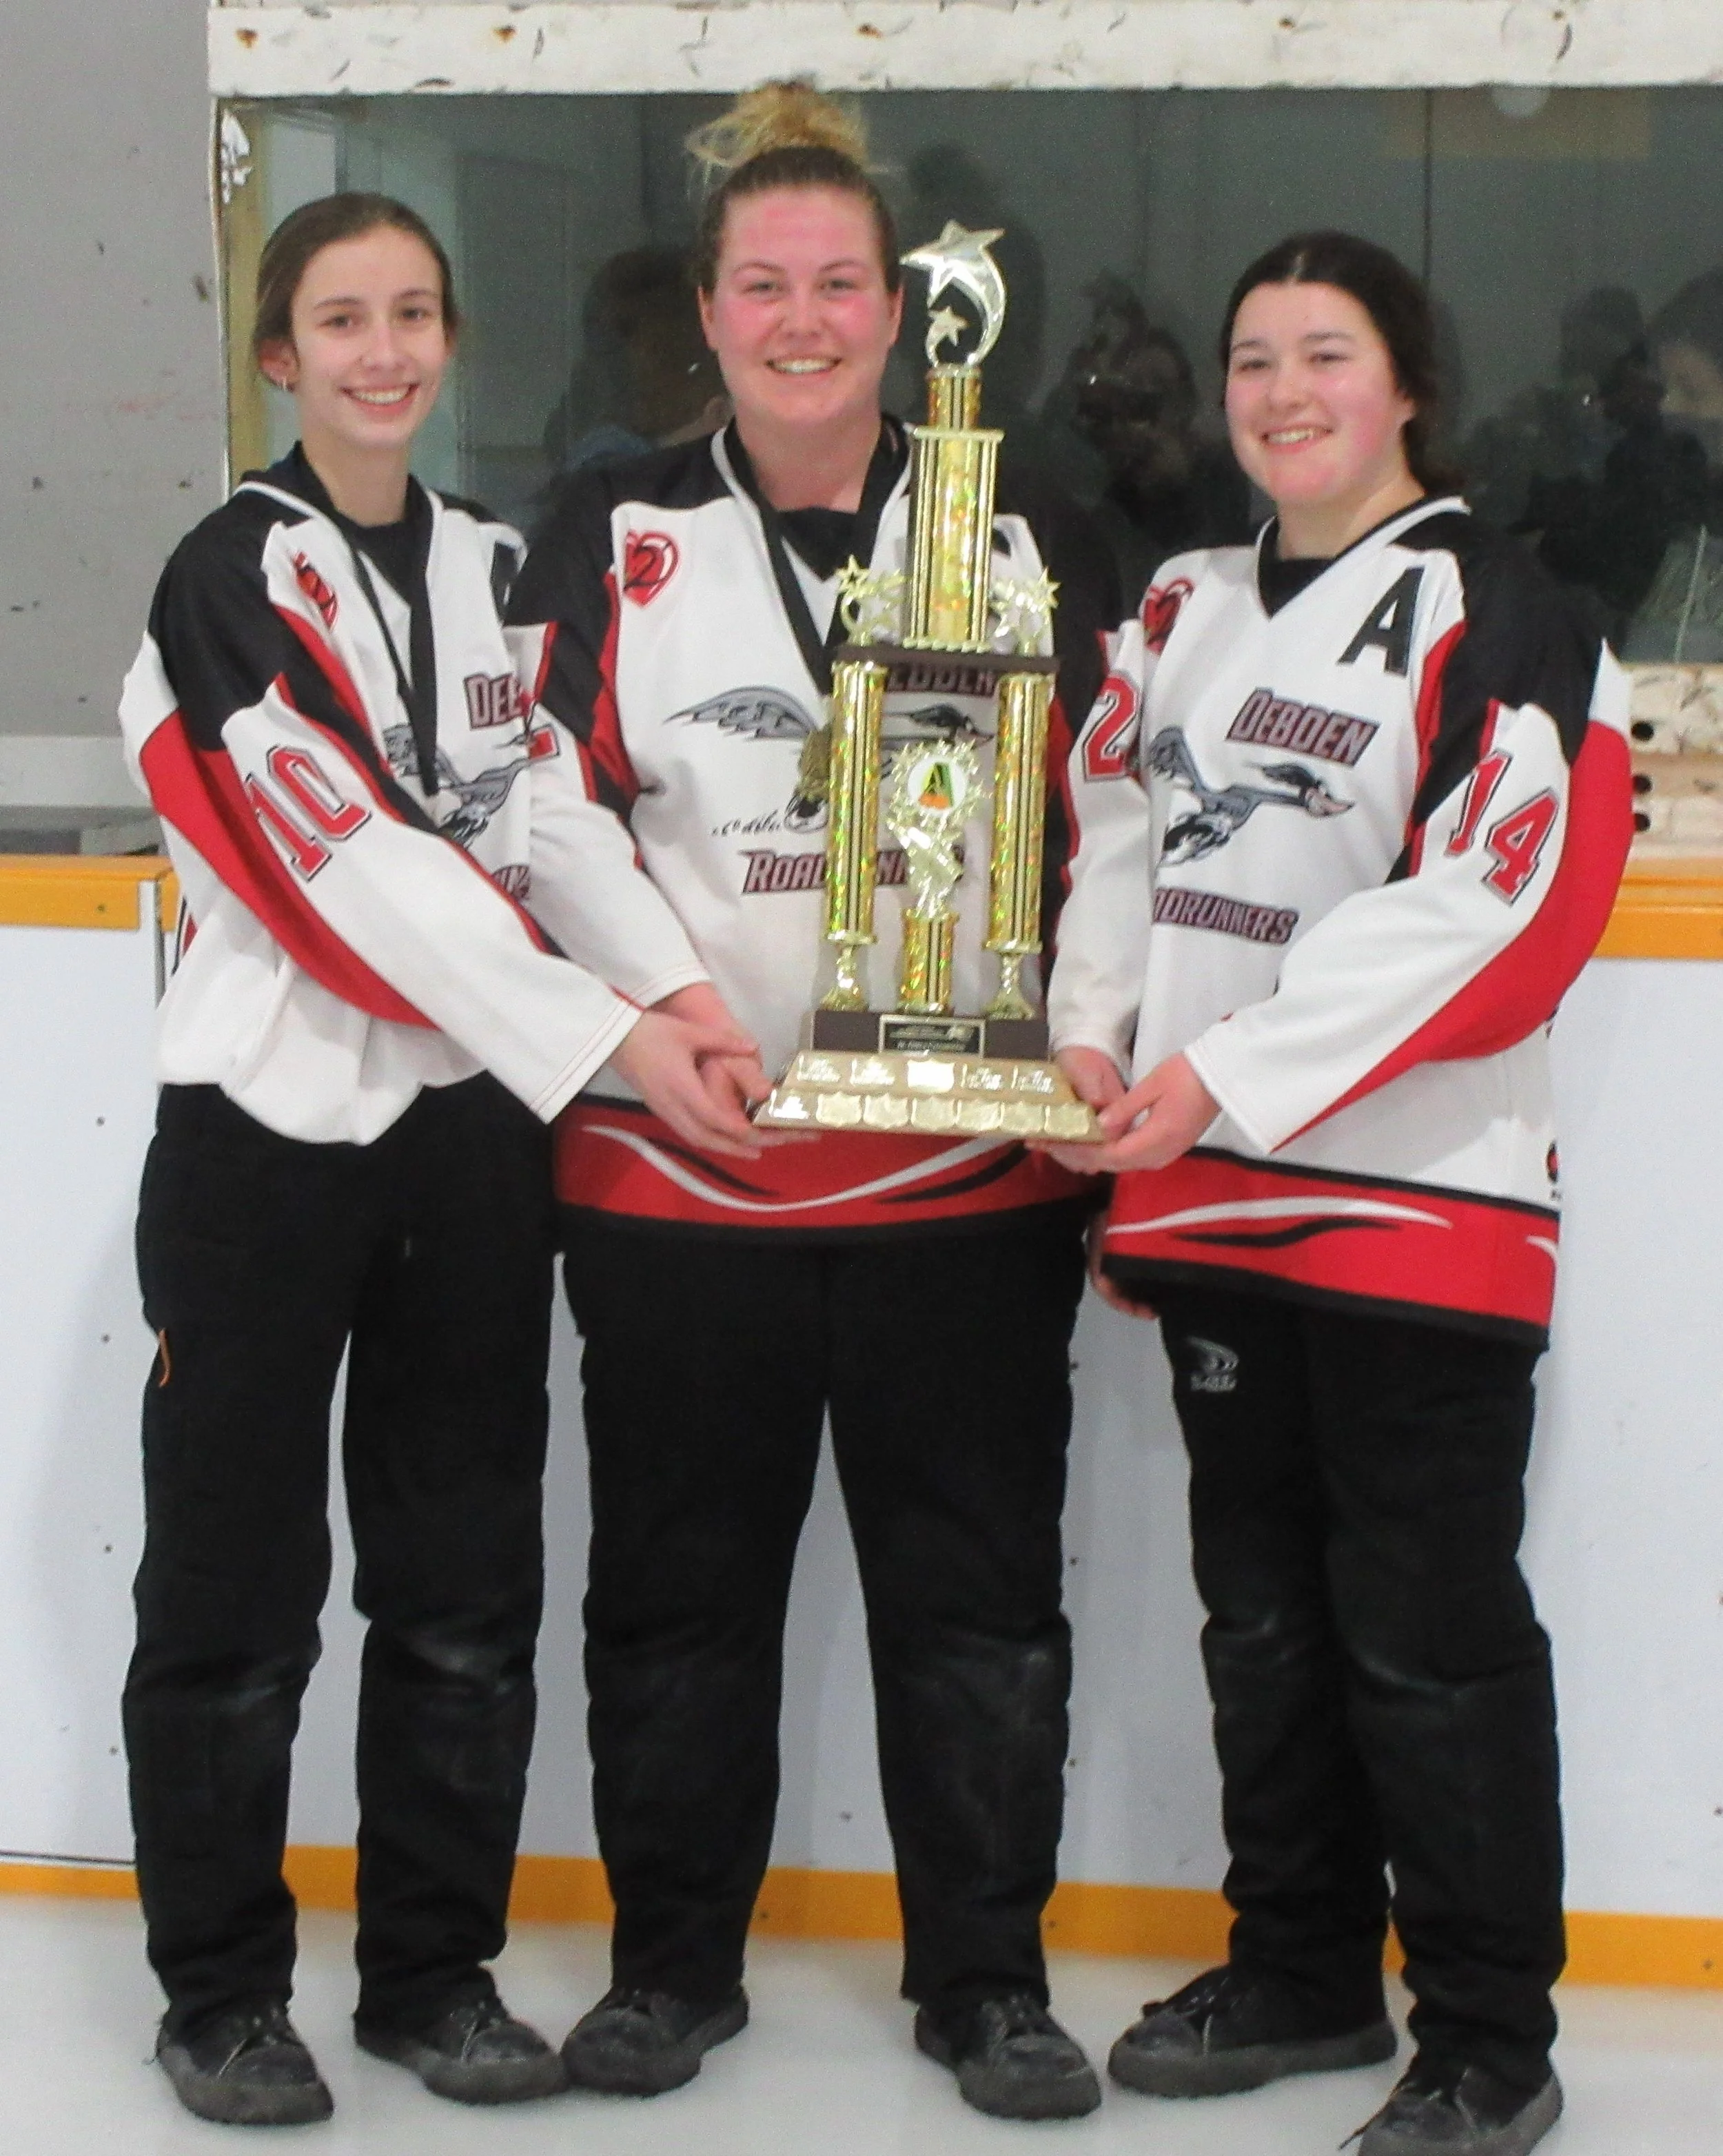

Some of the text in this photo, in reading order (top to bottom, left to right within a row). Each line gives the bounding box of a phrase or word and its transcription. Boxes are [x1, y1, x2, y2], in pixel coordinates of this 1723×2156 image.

[1336, 566, 1425, 677] A
[1225, 688, 1381, 766] DEBDEN
[245, 744, 372, 881] 10
[1445, 749, 1559, 907] 14
